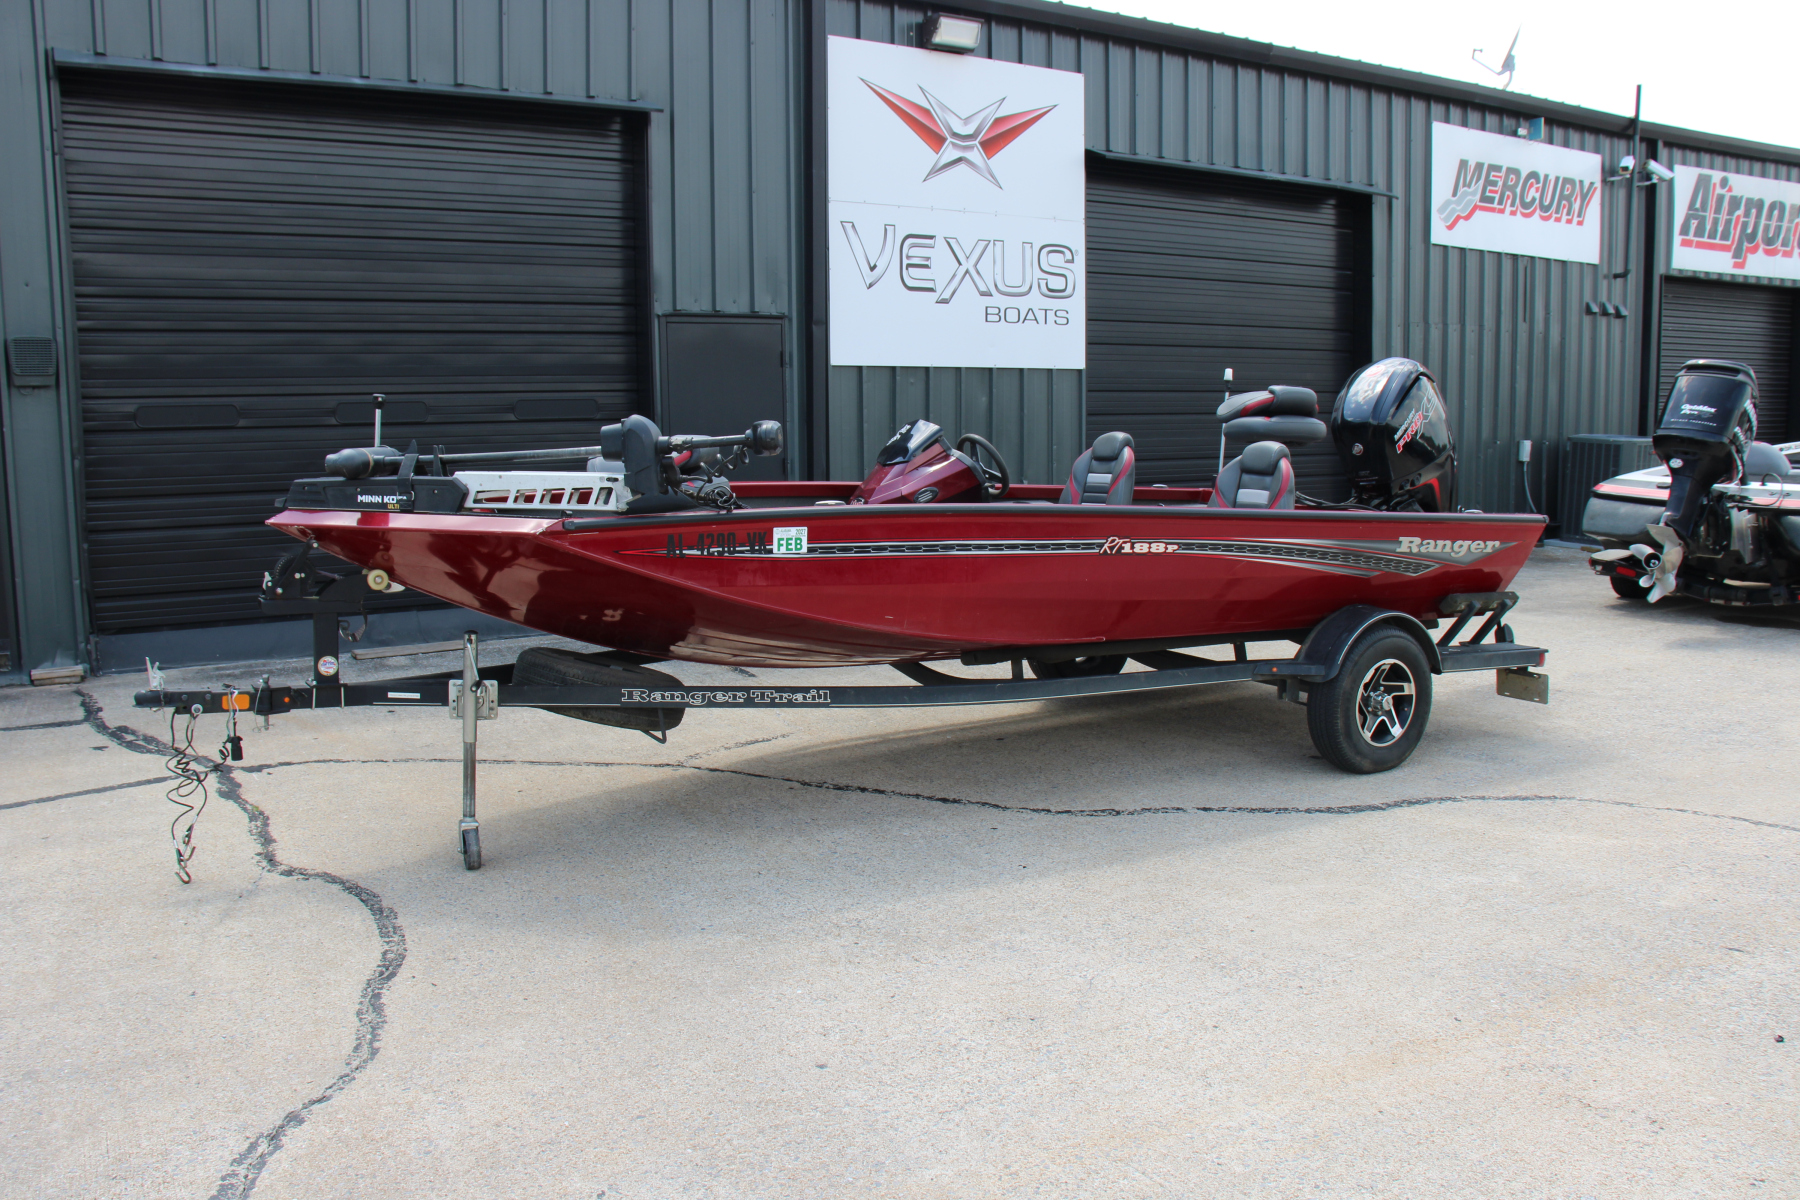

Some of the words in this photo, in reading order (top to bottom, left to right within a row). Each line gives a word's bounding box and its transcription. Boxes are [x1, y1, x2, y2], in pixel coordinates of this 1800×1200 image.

[1450, 158, 1597, 227] MERCURY
[1679, 172, 1800, 262] Airpor
[839, 220, 1076, 304] VEXUS
[984, 306, 1070, 326] BOATS
[357, 494, 382, 503] MINN
[777, 537, 803, 552] FEB
[1395, 536, 1500, 558] Ranger
[621, 688, 747, 706] Ranger
[750, 689, 831, 703] Trail
